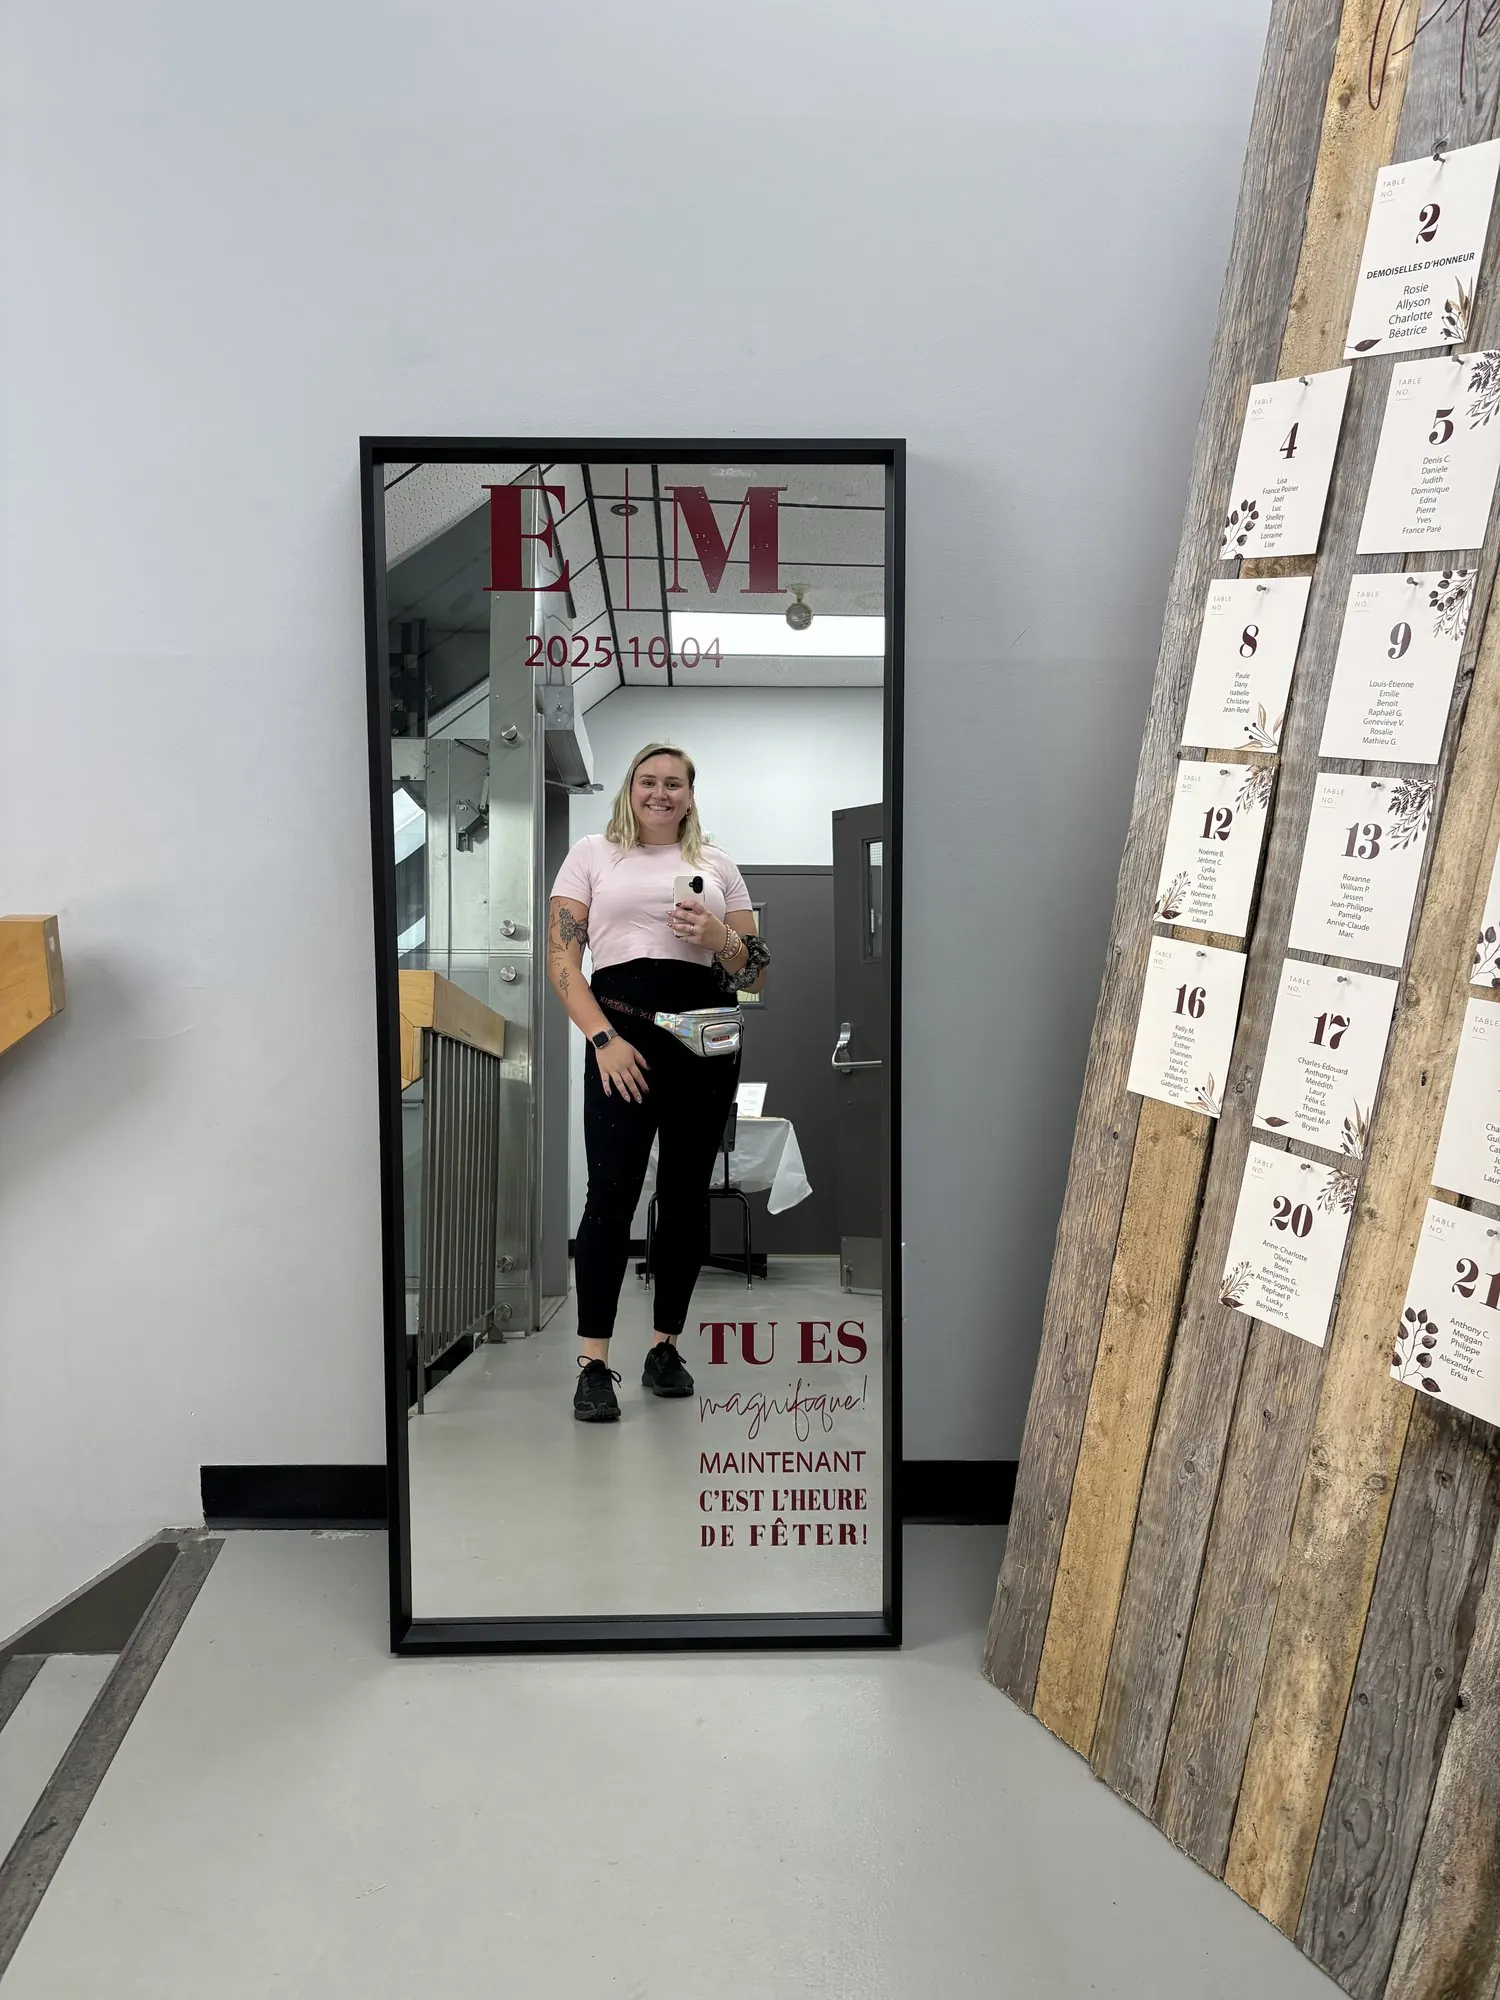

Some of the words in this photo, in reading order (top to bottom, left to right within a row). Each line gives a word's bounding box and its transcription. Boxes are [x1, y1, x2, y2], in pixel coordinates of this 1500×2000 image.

[1382, 177, 1406, 189] TABLE
[1416, 203, 1441, 244] 2
[1366, 262, 1423, 279] DEMOISELLES
[1424, 252, 1475, 270] D'HONNEUR
[1403, 283, 1429, 295] Rosie
[1396, 298, 1430, 311] Allyson
[1388, 310, 1433, 325] Charlotte
[1388, 325, 1427, 339] Béatrice
[1399, 377, 1422, 386] TABLE
[1254, 397, 1272, 405] TABLE
[1429, 405, 1455, 445] 5
[1279, 422, 1299, 460] 4
[1423, 456, 1443, 465] Denis
[1444, 455, 1451, 463] C.
[1421, 476, 1443, 485] Judith
[1262, 487, 1280, 495] France
[1411, 486, 1450, 495] Dominique
[1419, 496, 1437, 504] Edna
[1416, 506, 1436, 514] Pierre
[1265, 514, 1285, 522] Shelley
[1416, 516, 1432, 524] Yves
[1426, 525, 1442, 533] Paré
[481, 485, 569, 592] E
[664, 486, 788, 594] M
[1260, 532, 1282, 540] Lorraine
[1239, 624, 1259, 658] 8
[1387, 622, 1412, 659] 9
[524, 635, 725, 669] 2025.10.04
[1234, 681, 1248, 689] Dany
[1369, 680, 1414, 689] Louis-Étienne
[1226, 698, 1250, 706] Christine
[1368, 709, 1395, 717] Raphaël
[1370, 728, 1394, 736] Rosalie
[1362, 737, 1389, 745] Mathieu
[1323, 787, 1345, 796] TABLE
[1200, 806, 1233, 841] 12
[1341, 822, 1383, 860] 13
[1198, 848, 1219, 857] Noémie
[1202, 866, 1216, 874] Lydia
[1197, 874, 1217, 883] Charles
[1342, 873, 1371, 884] Roxanne
[1198, 882, 1214, 891] Alexis
[1340, 883, 1364, 892] William
[1342, 893, 1364, 902] Jessen
[1330, 901, 1373, 913] Jean-Philippe
[1192, 916, 1207, 925] Laura
[1326, 918, 1370, 931] Annie-Claude
[1338, 929, 1355, 939] Marc
[1155, 950, 1172, 959] TABLE
[1289, 975, 1311, 986] TABLE
[1172, 984, 1207, 1019] 16
[1474, 1016, 1499, 1027] TABLE
[1175, 1024, 1188, 1034] Kelly
[1309, 1012, 1351, 1050] 17
[1172, 1032, 1196, 1044] Shannon
[1174, 1041, 1191, 1051] Esther
[1169, 1057, 1183, 1066] Louis
[1297, 1056, 1349, 1076] Charles-Édouard
[1164, 1072, 1183, 1083] William
[1304, 1068, 1332, 1082] Anthony
[1160, 1079, 1184, 1092] Gabrielle
[1168, 1090, 1179, 1099] Carl
[1309, 1087, 1327, 1099] Laury
[1305, 1096, 1319, 1106] Félix
[1302, 1104, 1326, 1116] Thomas
[1294, 1110, 1317, 1124] Samuel
[1317, 1118, 1331, 1127] M-P
[1301, 1122, 1320, 1133] Bryan
[1254, 1157, 1274, 1169] TABLE
[1270, 1195, 1313, 1238] 20
[1431, 1215, 1456, 1229] TABLE
[1262, 1239, 1308, 1262] Anne-Charlotte
[1273, 1253, 1293, 1266] Olivier
[1274, 1262, 1289, 1274] Boris
[1262, 1266, 1290, 1283] Benjamin
[1256, 1273, 1295, 1293] Anne-Sophie
[1451, 1257, 1500, 1312] 21
[1266, 1296, 1284, 1308] Lucky
[1256, 1300, 1284, 1317] Benjamin
[1449, 1317, 1482, 1337] Anthony
[700, 1322, 778, 1365] TU
[797, 1320, 868, 1364] ES
[1452, 1329, 1483, 1346] Meggan
[1450, 1338, 1481, 1356] Philippe
[1453, 1349, 1473, 1364] Jinny
[1438, 1354, 1475, 1374] Alexandre
[1450, 1368, 1468, 1382] Erkia
[699, 1375, 868, 1442] magnifique!
[700, 1451, 867, 1474] MAINTENANT
[700, 1489, 764, 1513] C'EST
[772, 1488, 867, 1511] L'HEURE
[701, 1524, 734, 1547] DE
[749, 1517, 867, 1547] FÊTER!
